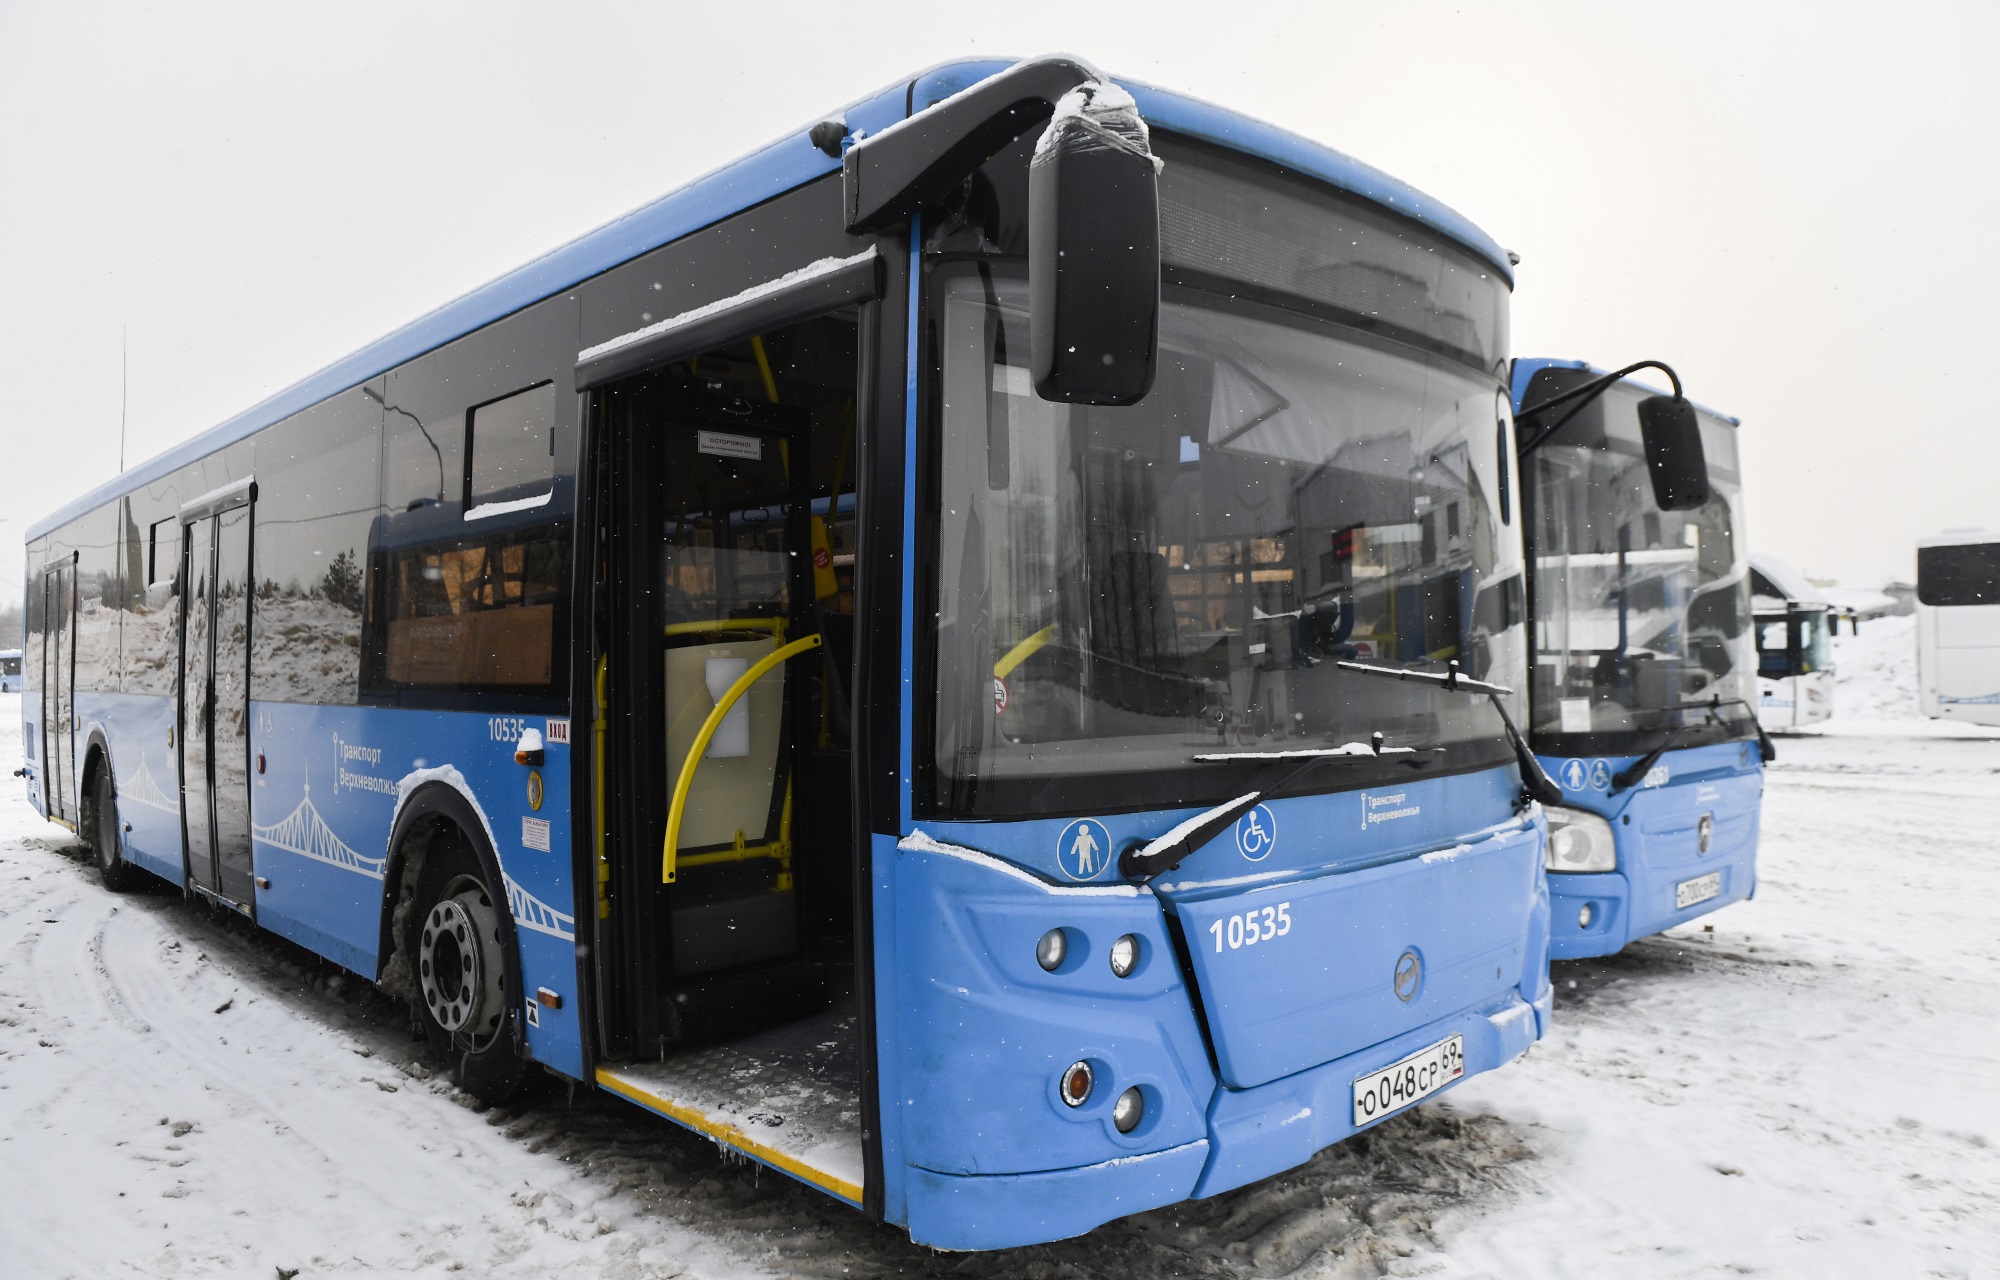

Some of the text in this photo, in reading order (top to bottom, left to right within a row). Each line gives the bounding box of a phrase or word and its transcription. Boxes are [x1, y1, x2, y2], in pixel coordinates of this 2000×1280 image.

[709, 437, 751, 448] ОСТОРОЖНО!
[488, 717, 525, 743] 10535
[549, 722, 567, 742] ВХОД
[339, 740, 382, 768] Транспорт
[340, 767, 402, 796] Верхневолжья
[1367, 793, 1406, 810] Транспорт
[1209, 901, 1292, 953] 10535
[1442, 1042, 1457, 1070] 69
